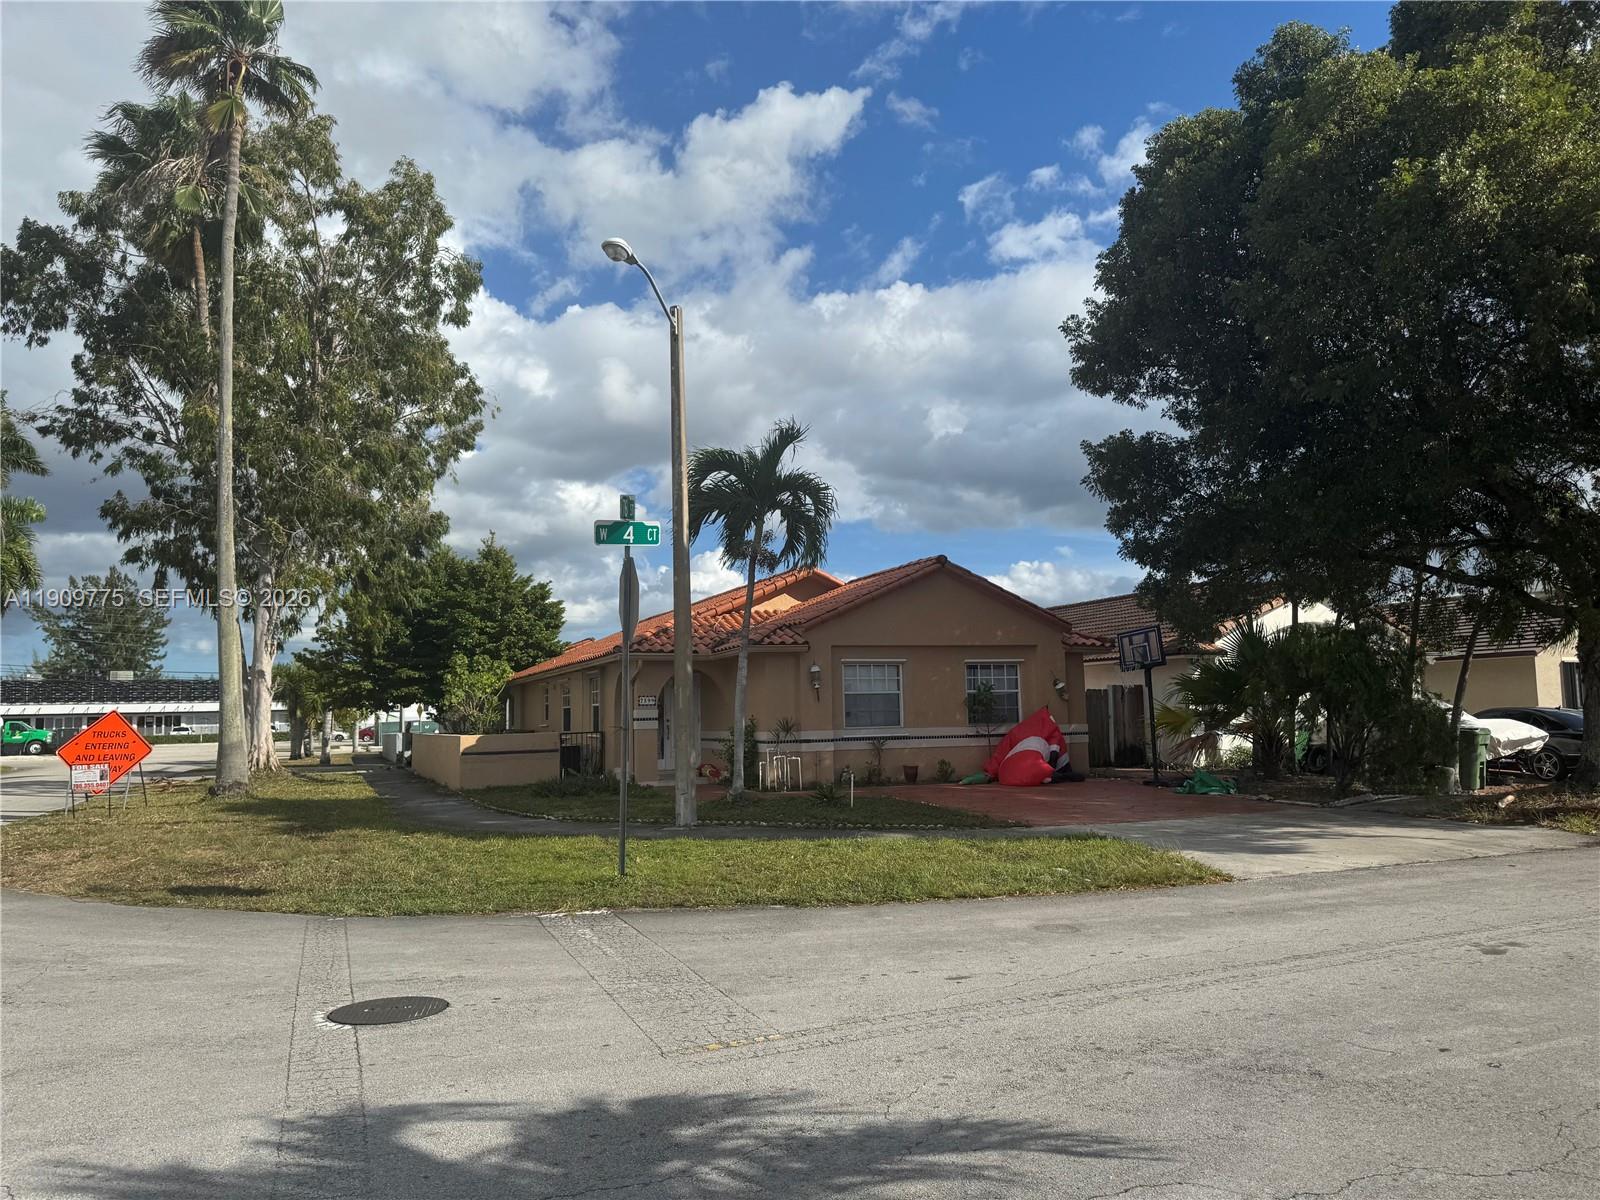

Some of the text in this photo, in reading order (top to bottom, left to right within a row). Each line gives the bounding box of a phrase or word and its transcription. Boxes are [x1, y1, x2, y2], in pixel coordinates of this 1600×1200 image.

[600, 525, 658, 543] W 4 CT
[85, 742, 129, 750] ENTERING
[74, 753, 136, 762] AND LEAVING
